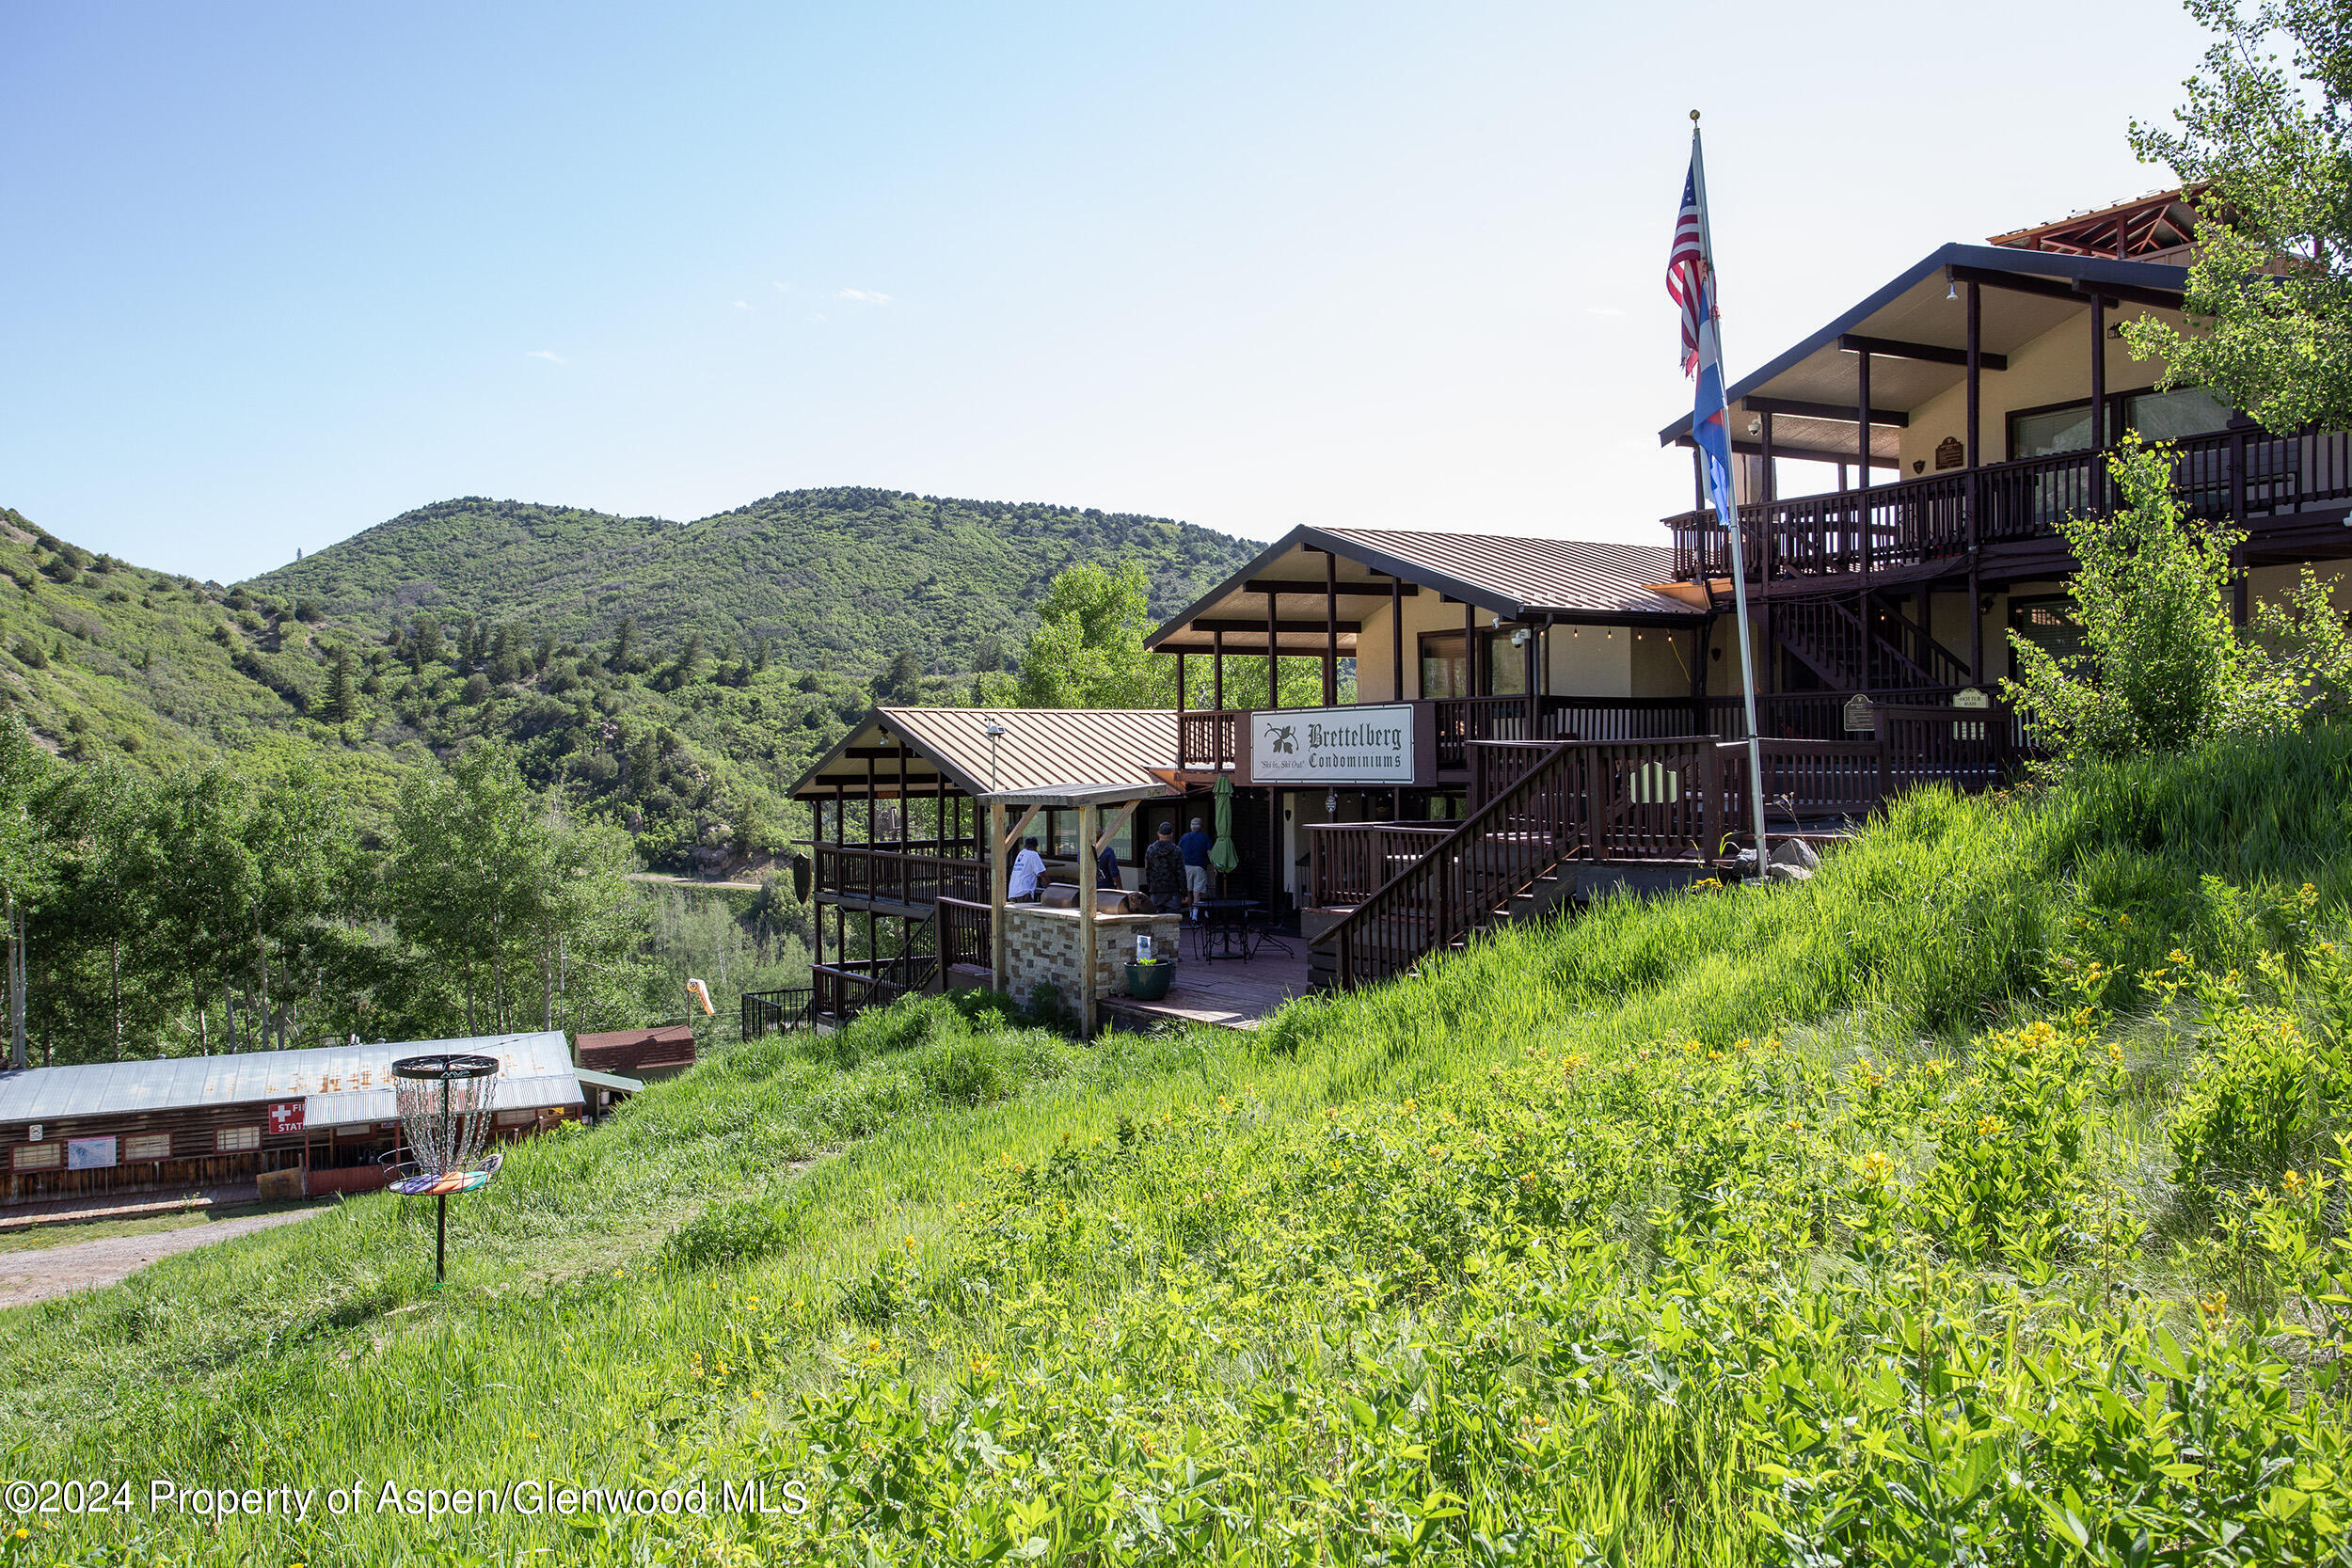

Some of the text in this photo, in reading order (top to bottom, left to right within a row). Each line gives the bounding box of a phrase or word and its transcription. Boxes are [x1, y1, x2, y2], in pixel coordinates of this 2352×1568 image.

[1308, 722, 1402, 752] Brettelberg
[1309, 752, 1401, 768] Condominiums
[278, 1121, 303, 1132] STAT
